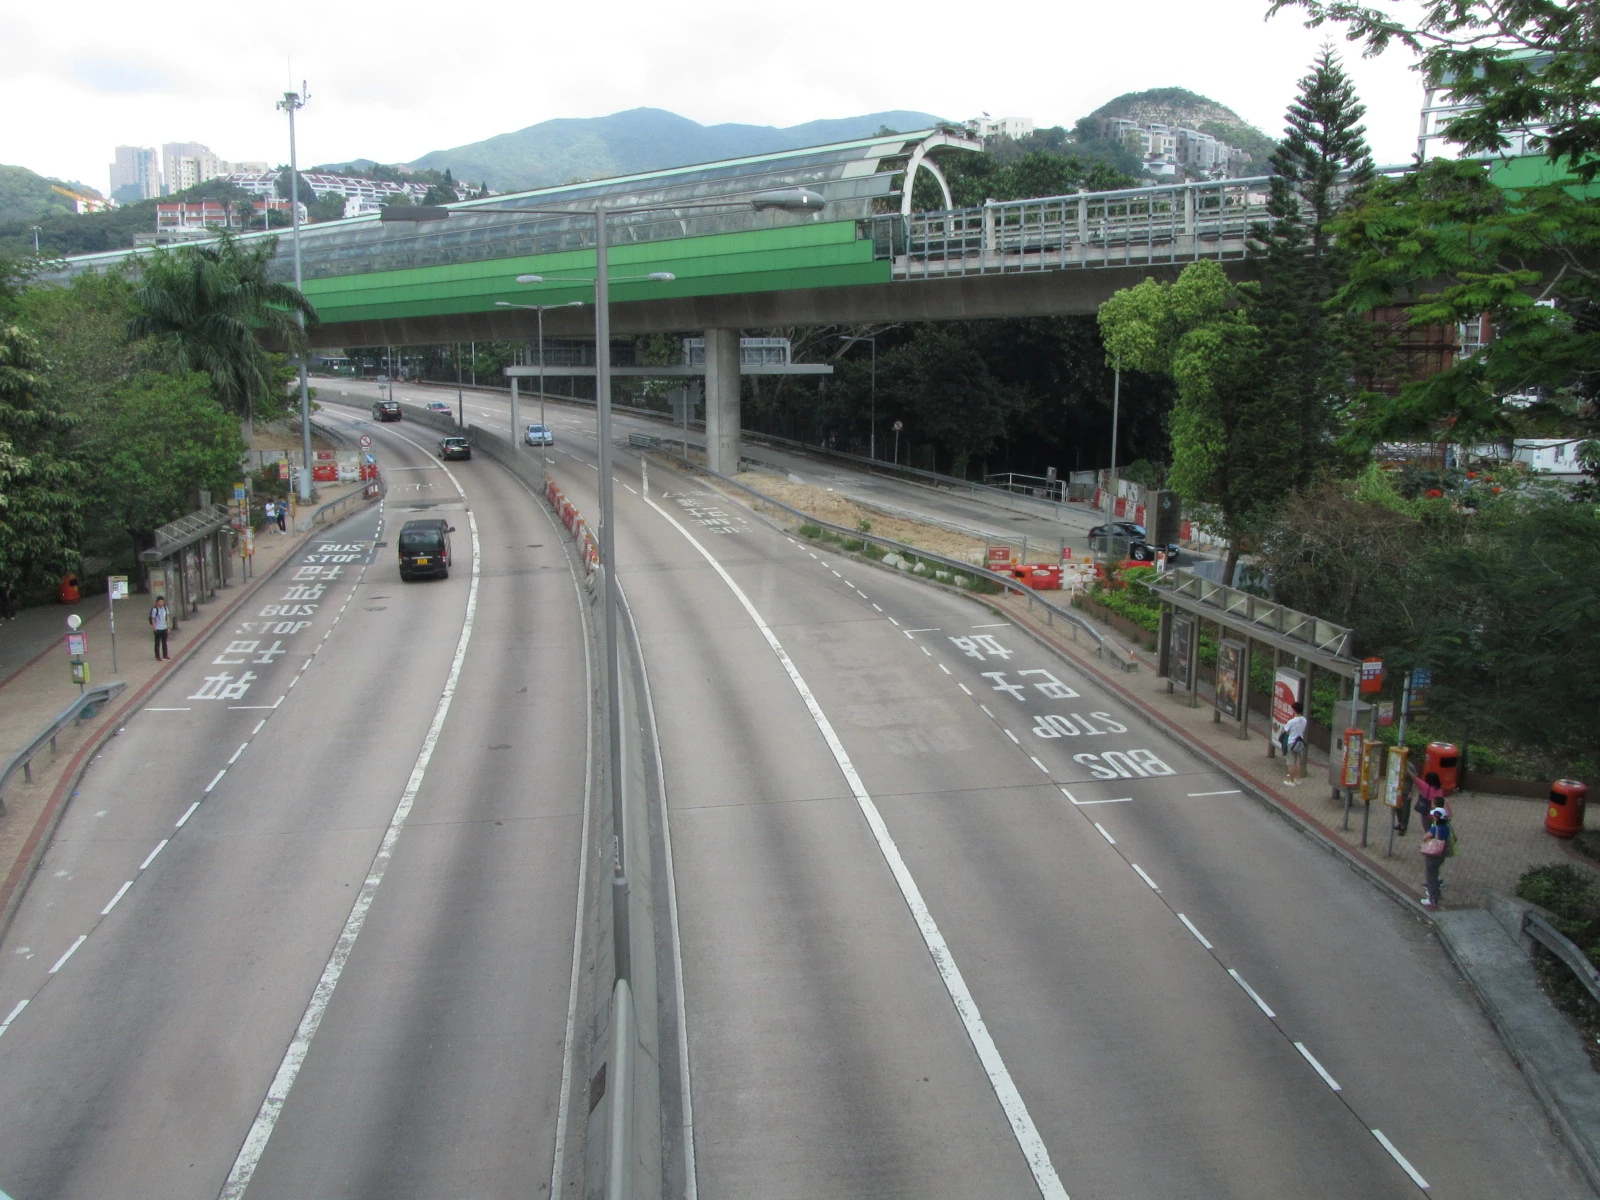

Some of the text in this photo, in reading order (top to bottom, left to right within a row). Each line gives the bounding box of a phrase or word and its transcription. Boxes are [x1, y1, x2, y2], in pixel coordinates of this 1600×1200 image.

[303, 554, 362, 563] STOP
[318, 544, 365, 552] BUS
[292, 565, 344, 581] 巴士
[279, 583, 327, 600] 站
[258, 604, 319, 617] BUS
[235, 621, 313, 635] STOP
[212, 640, 287, 665] 巴士
[947, 634, 1014, 661] 站
[186, 671, 258, 700] 站
[980, 668, 1081, 701] 巴士
[1032, 711, 1128, 739] STOP
[1072, 748, 1178, 779] BUS
